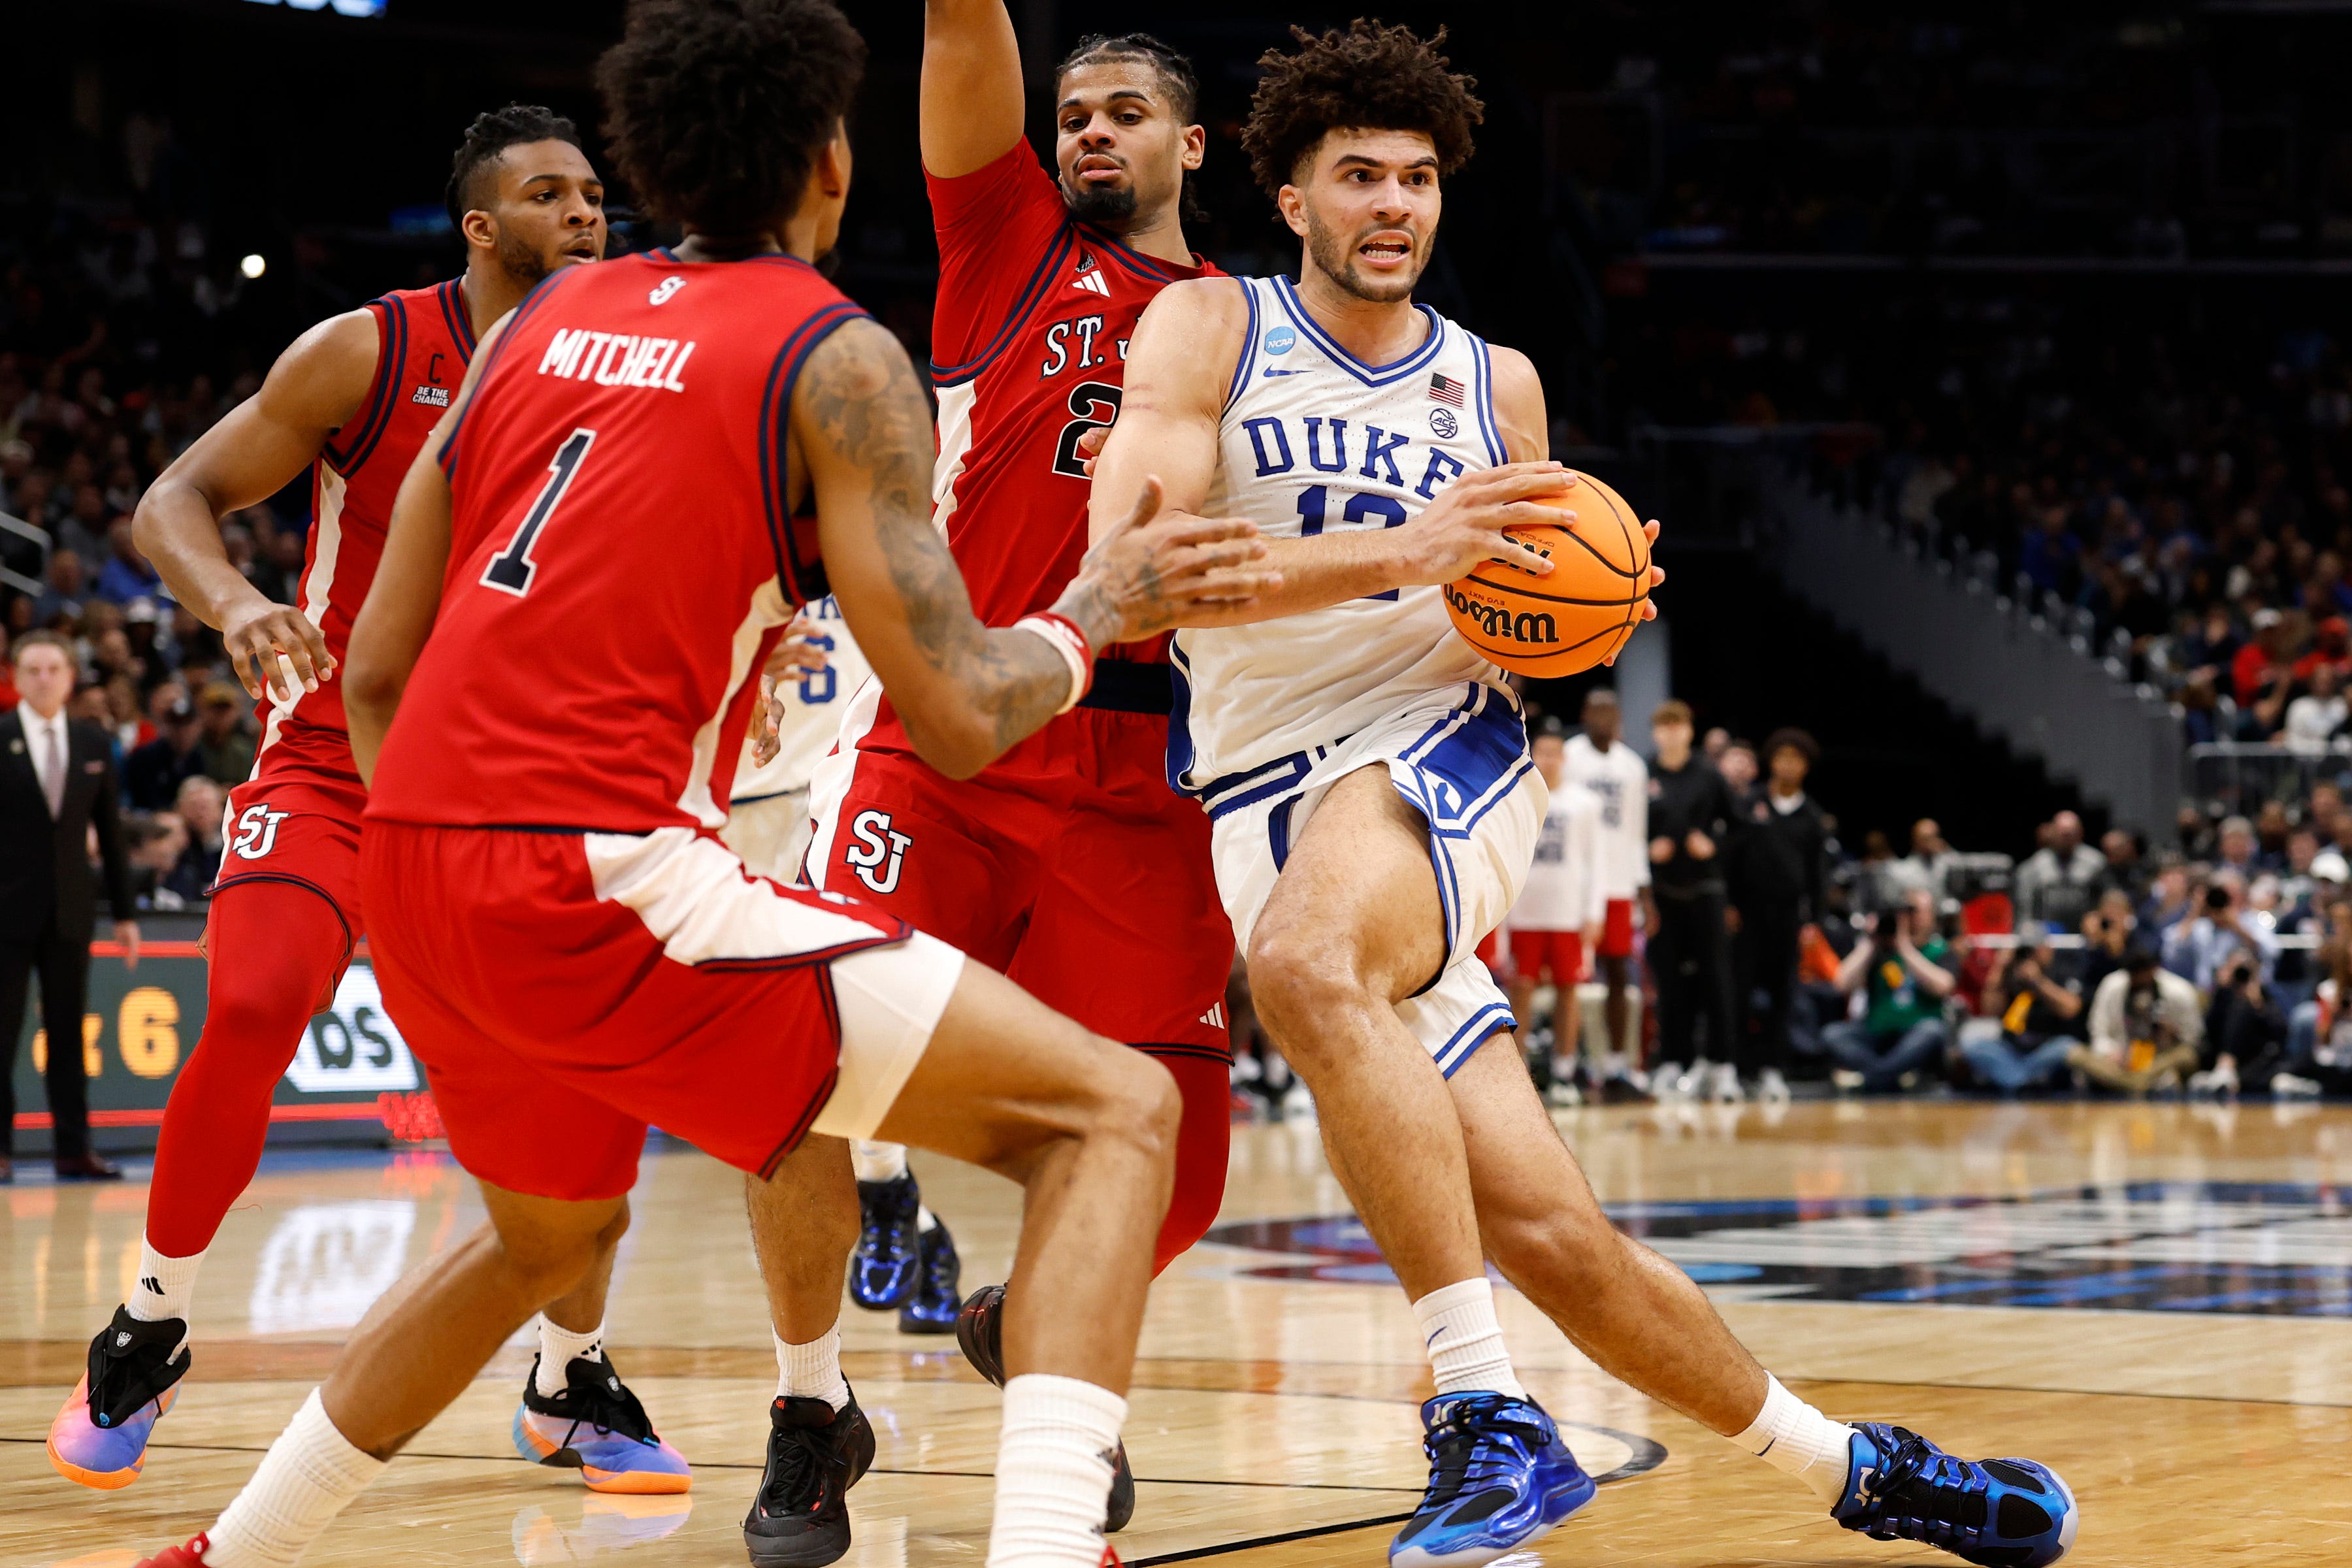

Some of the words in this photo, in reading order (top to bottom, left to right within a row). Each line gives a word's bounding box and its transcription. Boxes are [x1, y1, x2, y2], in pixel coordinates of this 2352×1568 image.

[1040, 314, 1104, 380] ST.
[1267, 337, 1294, 348] NCAA
[429, 353, 444, 384] C
[538, 327, 696, 393] MITCHELL
[412, 394, 449, 407] CHANGE
[417, 386, 430, 395] BE
[431, 388, 448, 398] THE
[1433, 417, 1456, 429] ACC
[1242, 417, 1464, 500] DUKE
[479, 427, 597, 598] 1
[1469, 591, 1484, 601] NXT
[1487, 597, 1505, 606] EVO
[1443, 583, 1560, 643] Wilson
[118, 985, 180, 1079] 6
